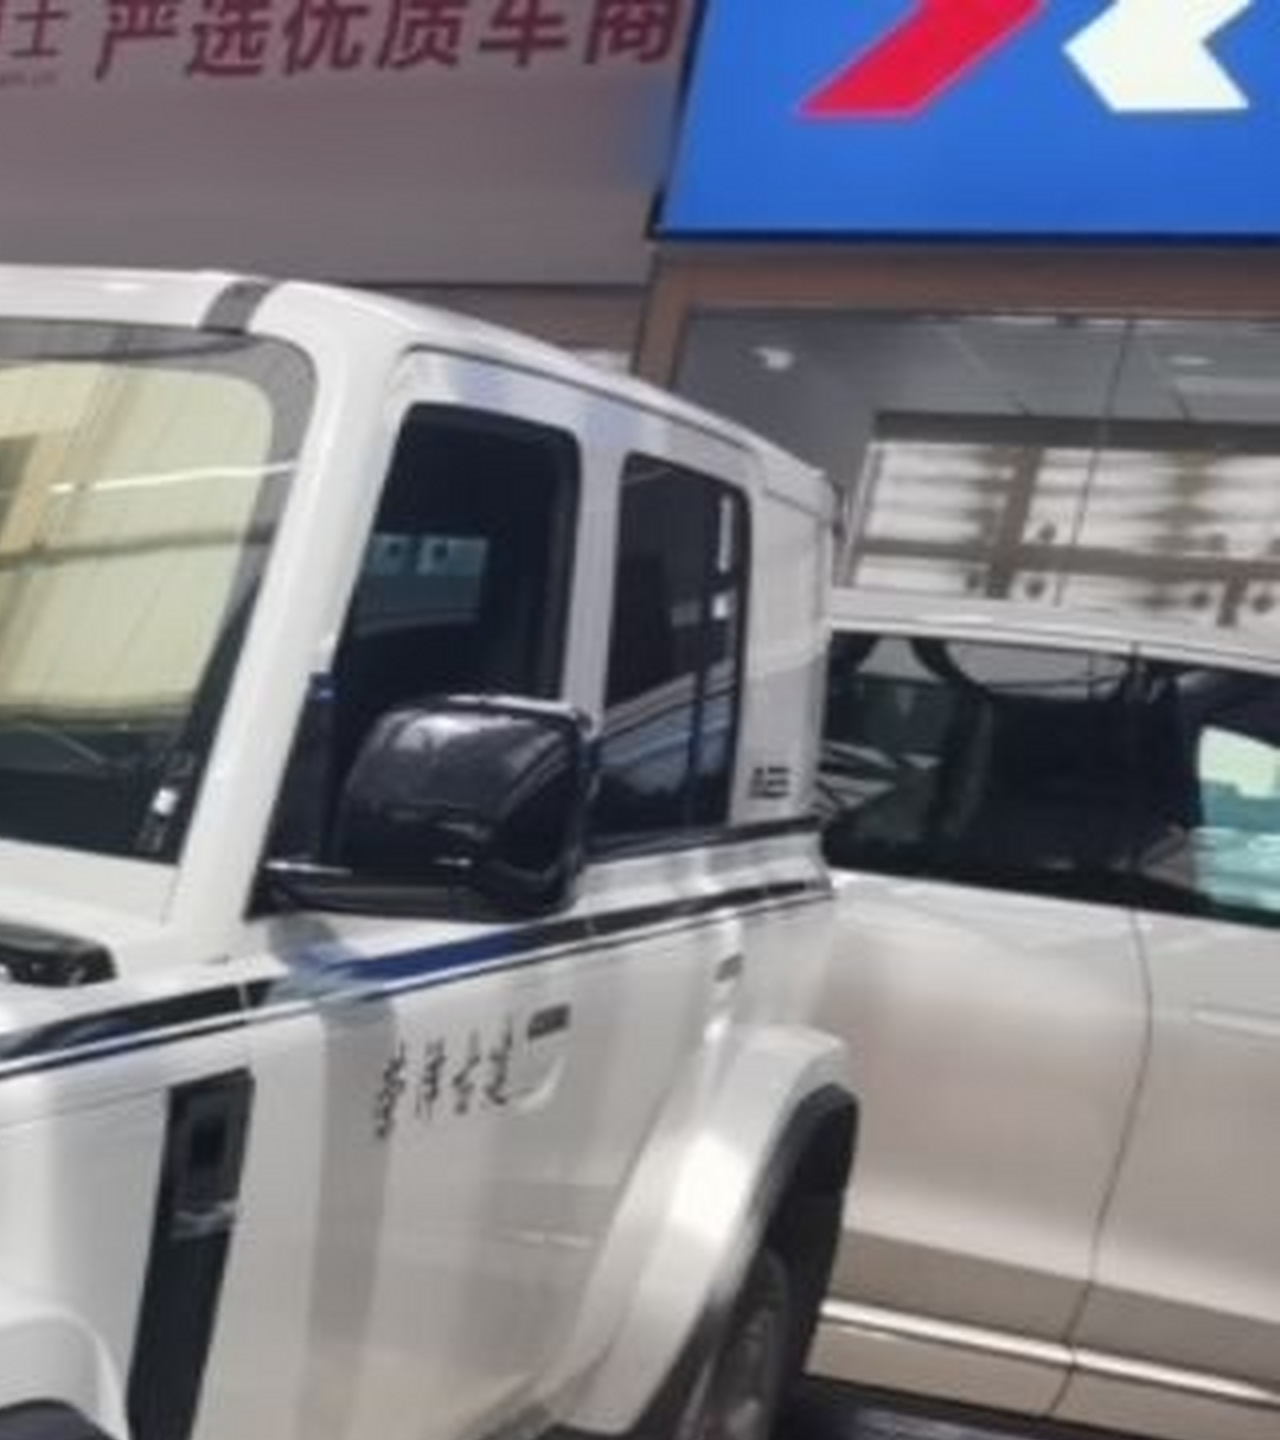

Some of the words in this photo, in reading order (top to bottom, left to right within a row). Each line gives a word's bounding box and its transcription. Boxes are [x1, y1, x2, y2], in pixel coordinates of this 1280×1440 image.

[94, 0, 682, 81] 严选优质车商
